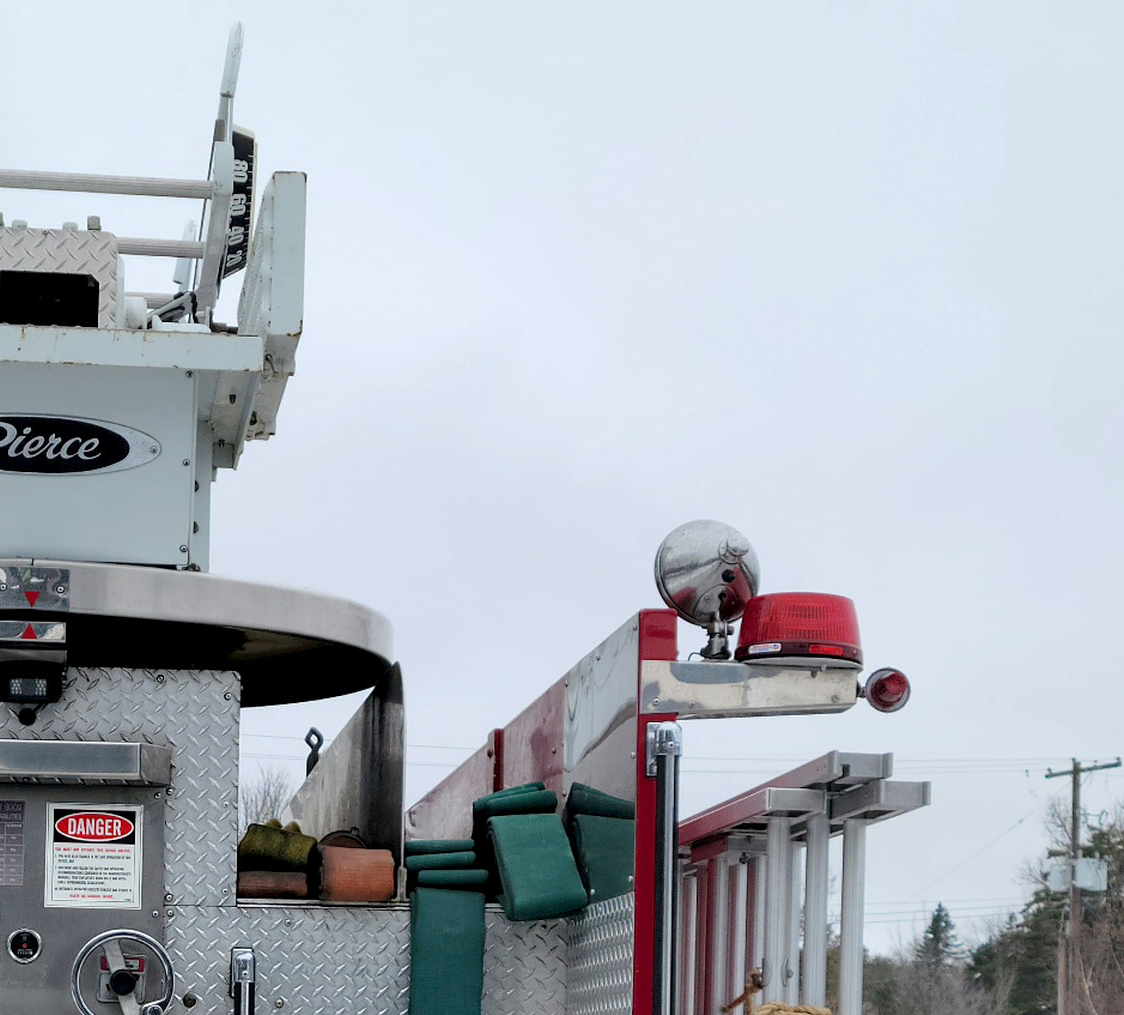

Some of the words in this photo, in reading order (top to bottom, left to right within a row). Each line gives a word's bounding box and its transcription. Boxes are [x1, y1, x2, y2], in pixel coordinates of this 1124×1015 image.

[233, 159, 248, 183] 80
[232, 193, 247, 217] 60
[228, 225, 245, 247] 40
[226, 250, 243, 267] 20
[67, 818, 122, 836] DANGER
